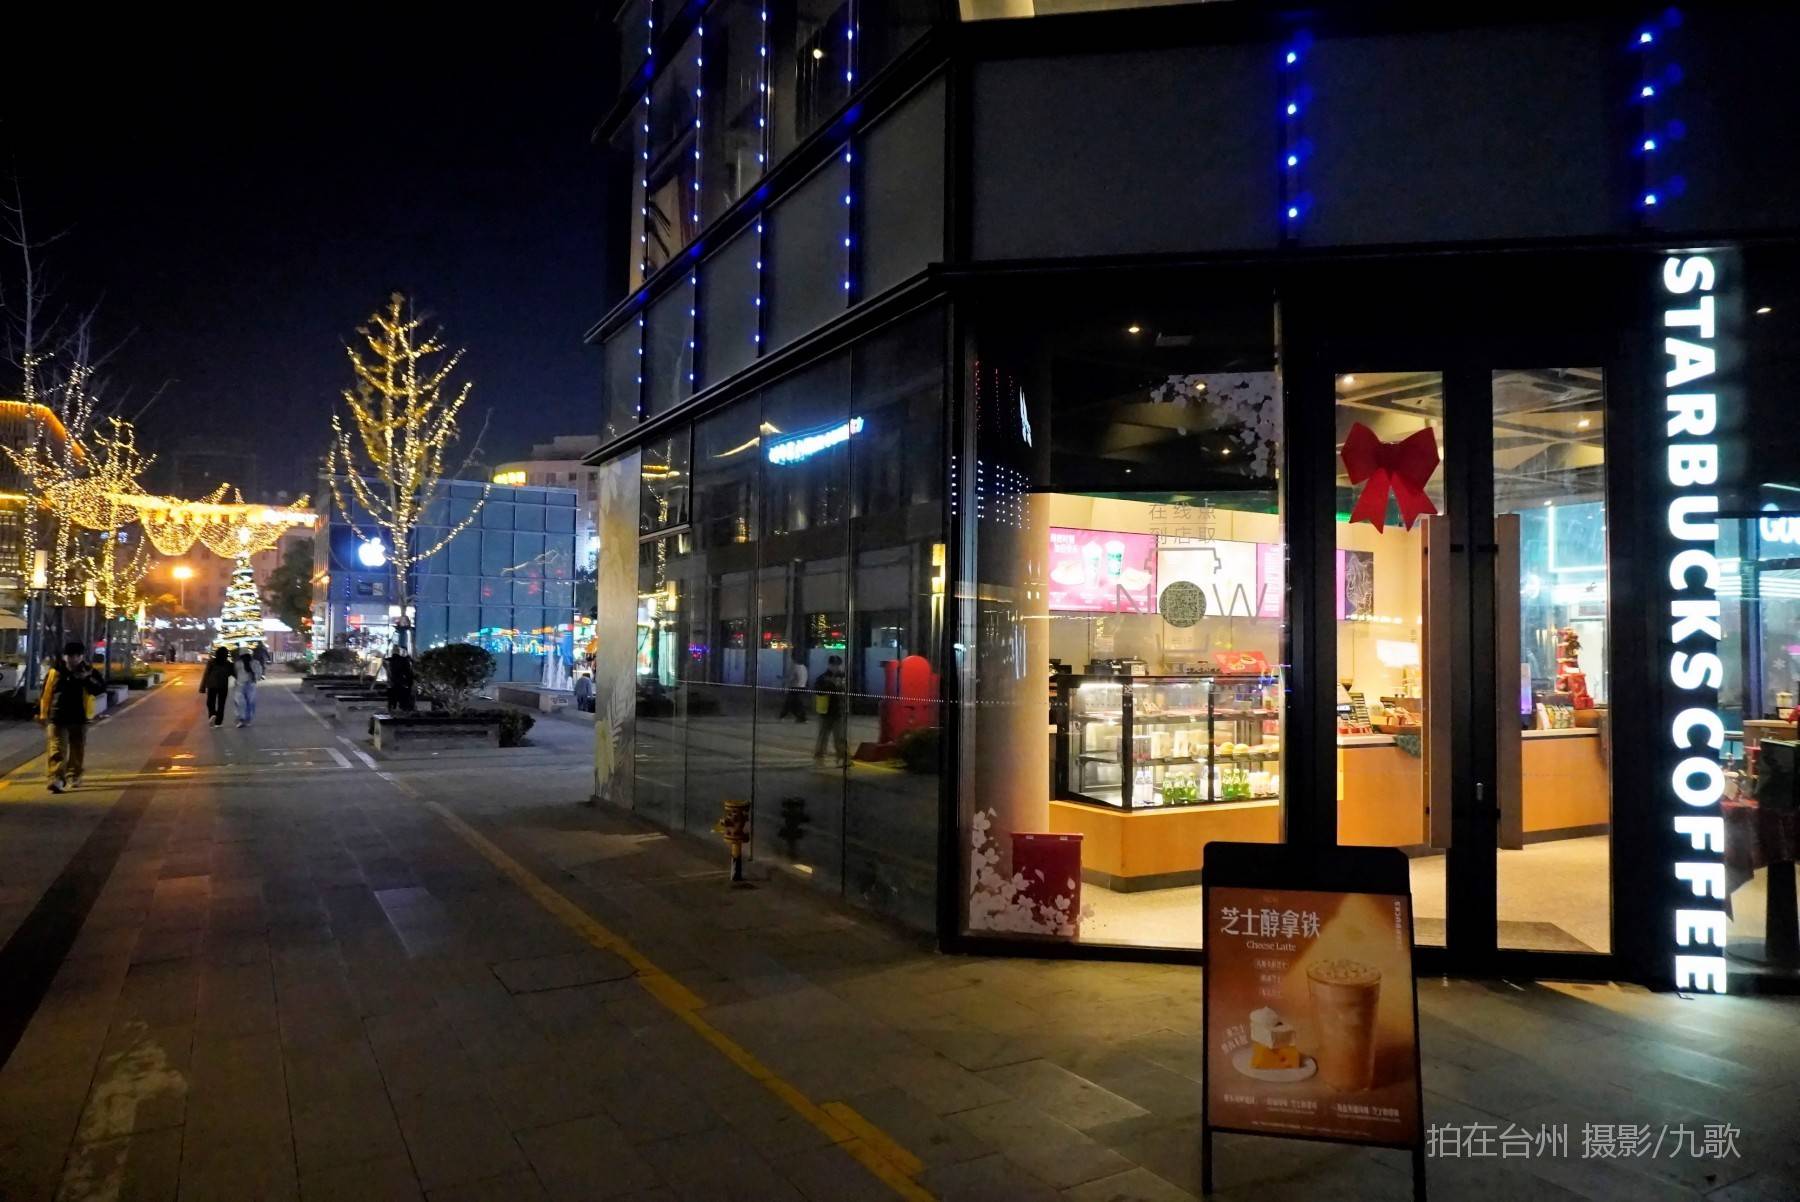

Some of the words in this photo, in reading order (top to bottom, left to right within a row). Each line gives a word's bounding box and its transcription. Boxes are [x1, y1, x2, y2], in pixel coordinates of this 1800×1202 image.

[1663, 256, 1725, 690] STARBUCKS
[1149, 526, 1217, 545] 到店取
[1671, 707, 1727, 994] COFFEE
[1220, 906, 1321, 938] 芝士醇拿铁
[1246, 940, 1275, 951] Cheese
[1276, 943, 1296, 952] Latte
